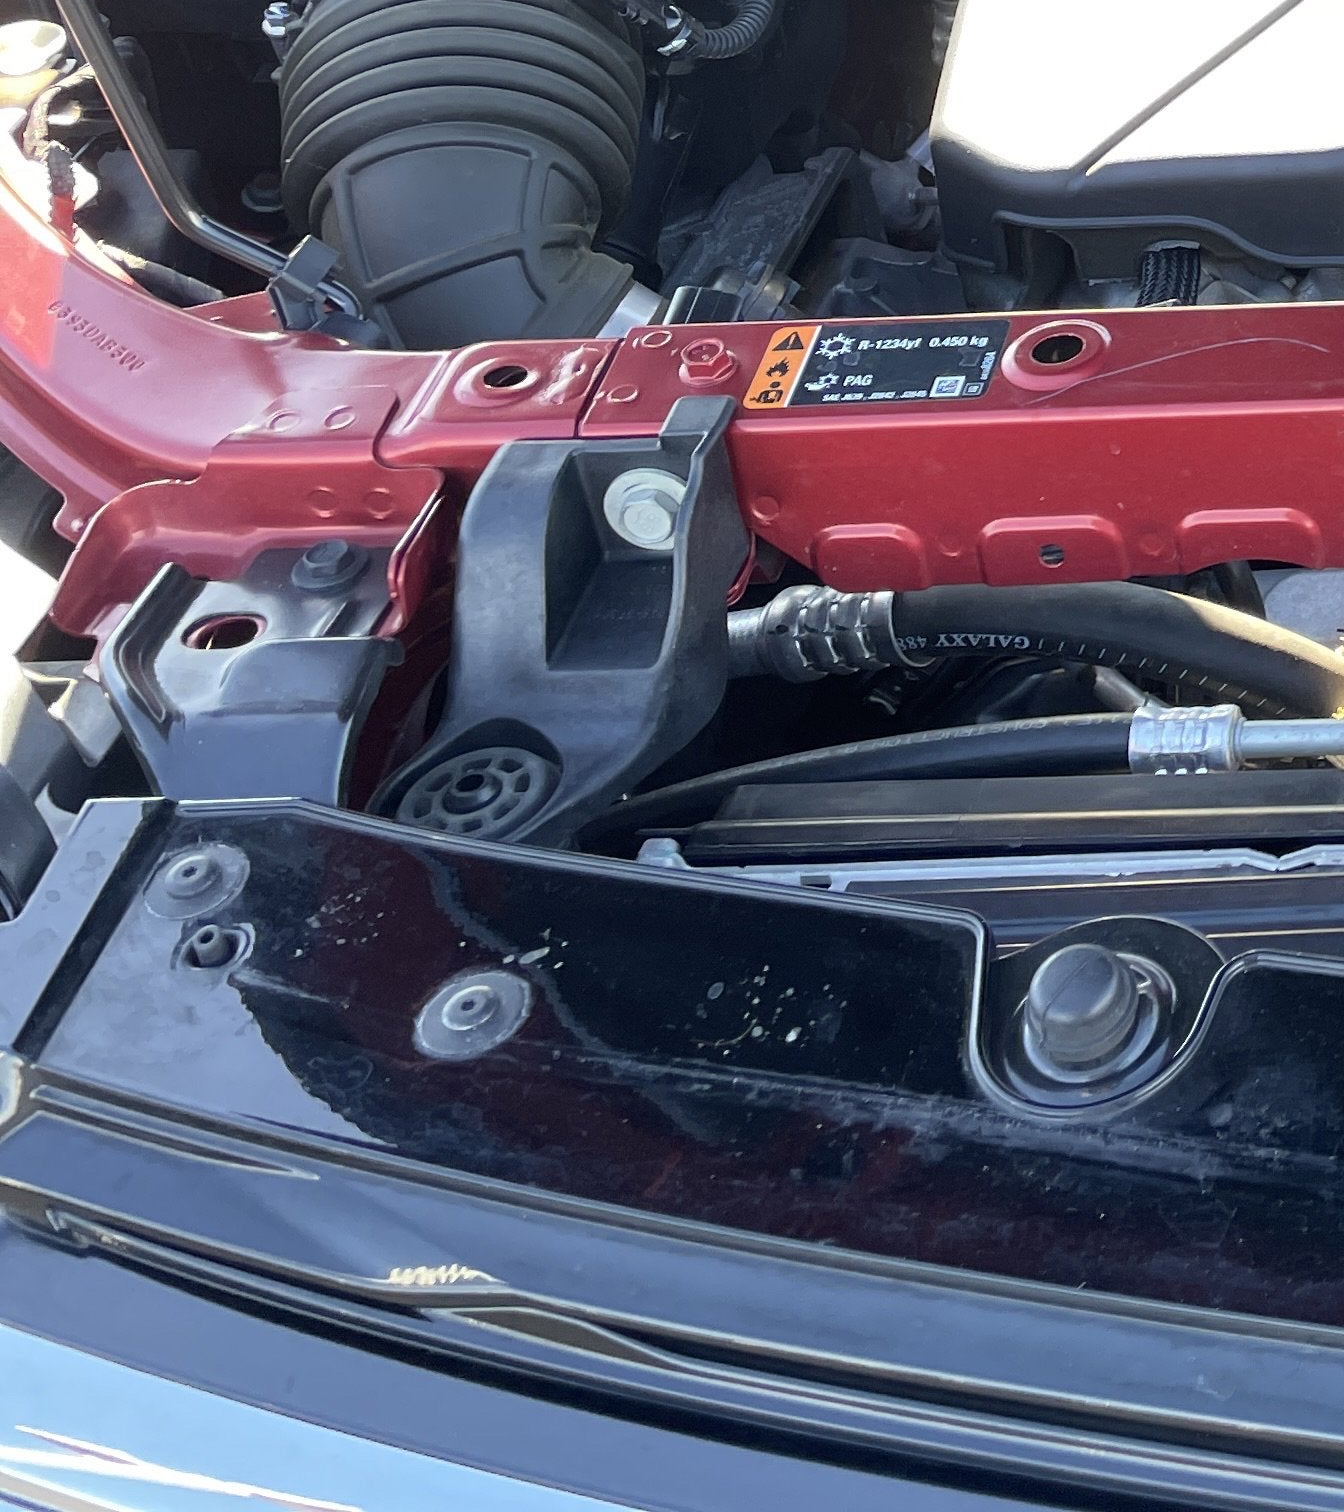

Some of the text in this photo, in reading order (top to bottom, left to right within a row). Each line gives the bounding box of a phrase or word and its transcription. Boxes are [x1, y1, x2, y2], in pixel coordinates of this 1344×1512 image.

[857, 336, 989, 351] R-1234yf 0.450 kg
[843, 374, 873, 387] PAG
[935, 633, 1030, 650] GALAXY
